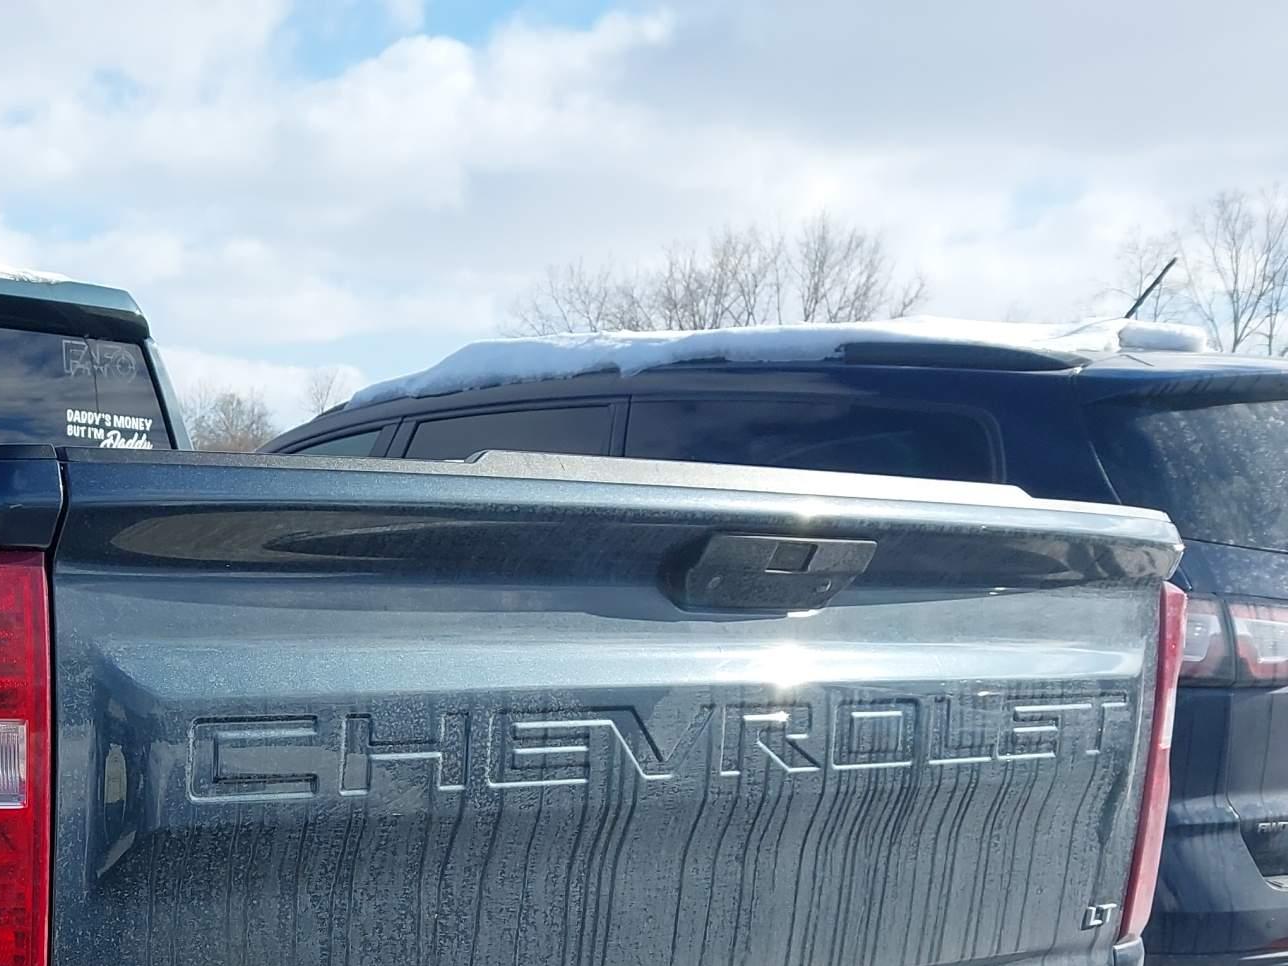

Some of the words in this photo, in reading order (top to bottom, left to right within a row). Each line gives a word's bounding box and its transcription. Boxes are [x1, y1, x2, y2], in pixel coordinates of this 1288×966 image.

[66, 408, 112, 427] DADDY'S
[113, 415, 153, 431] MONEY
[66, 424, 86, 438] BUT
[87, 427, 105, 440] I'M
[186, 689, 1128, 803] CHEVROLET
[1081, 902, 1117, 931] LT
